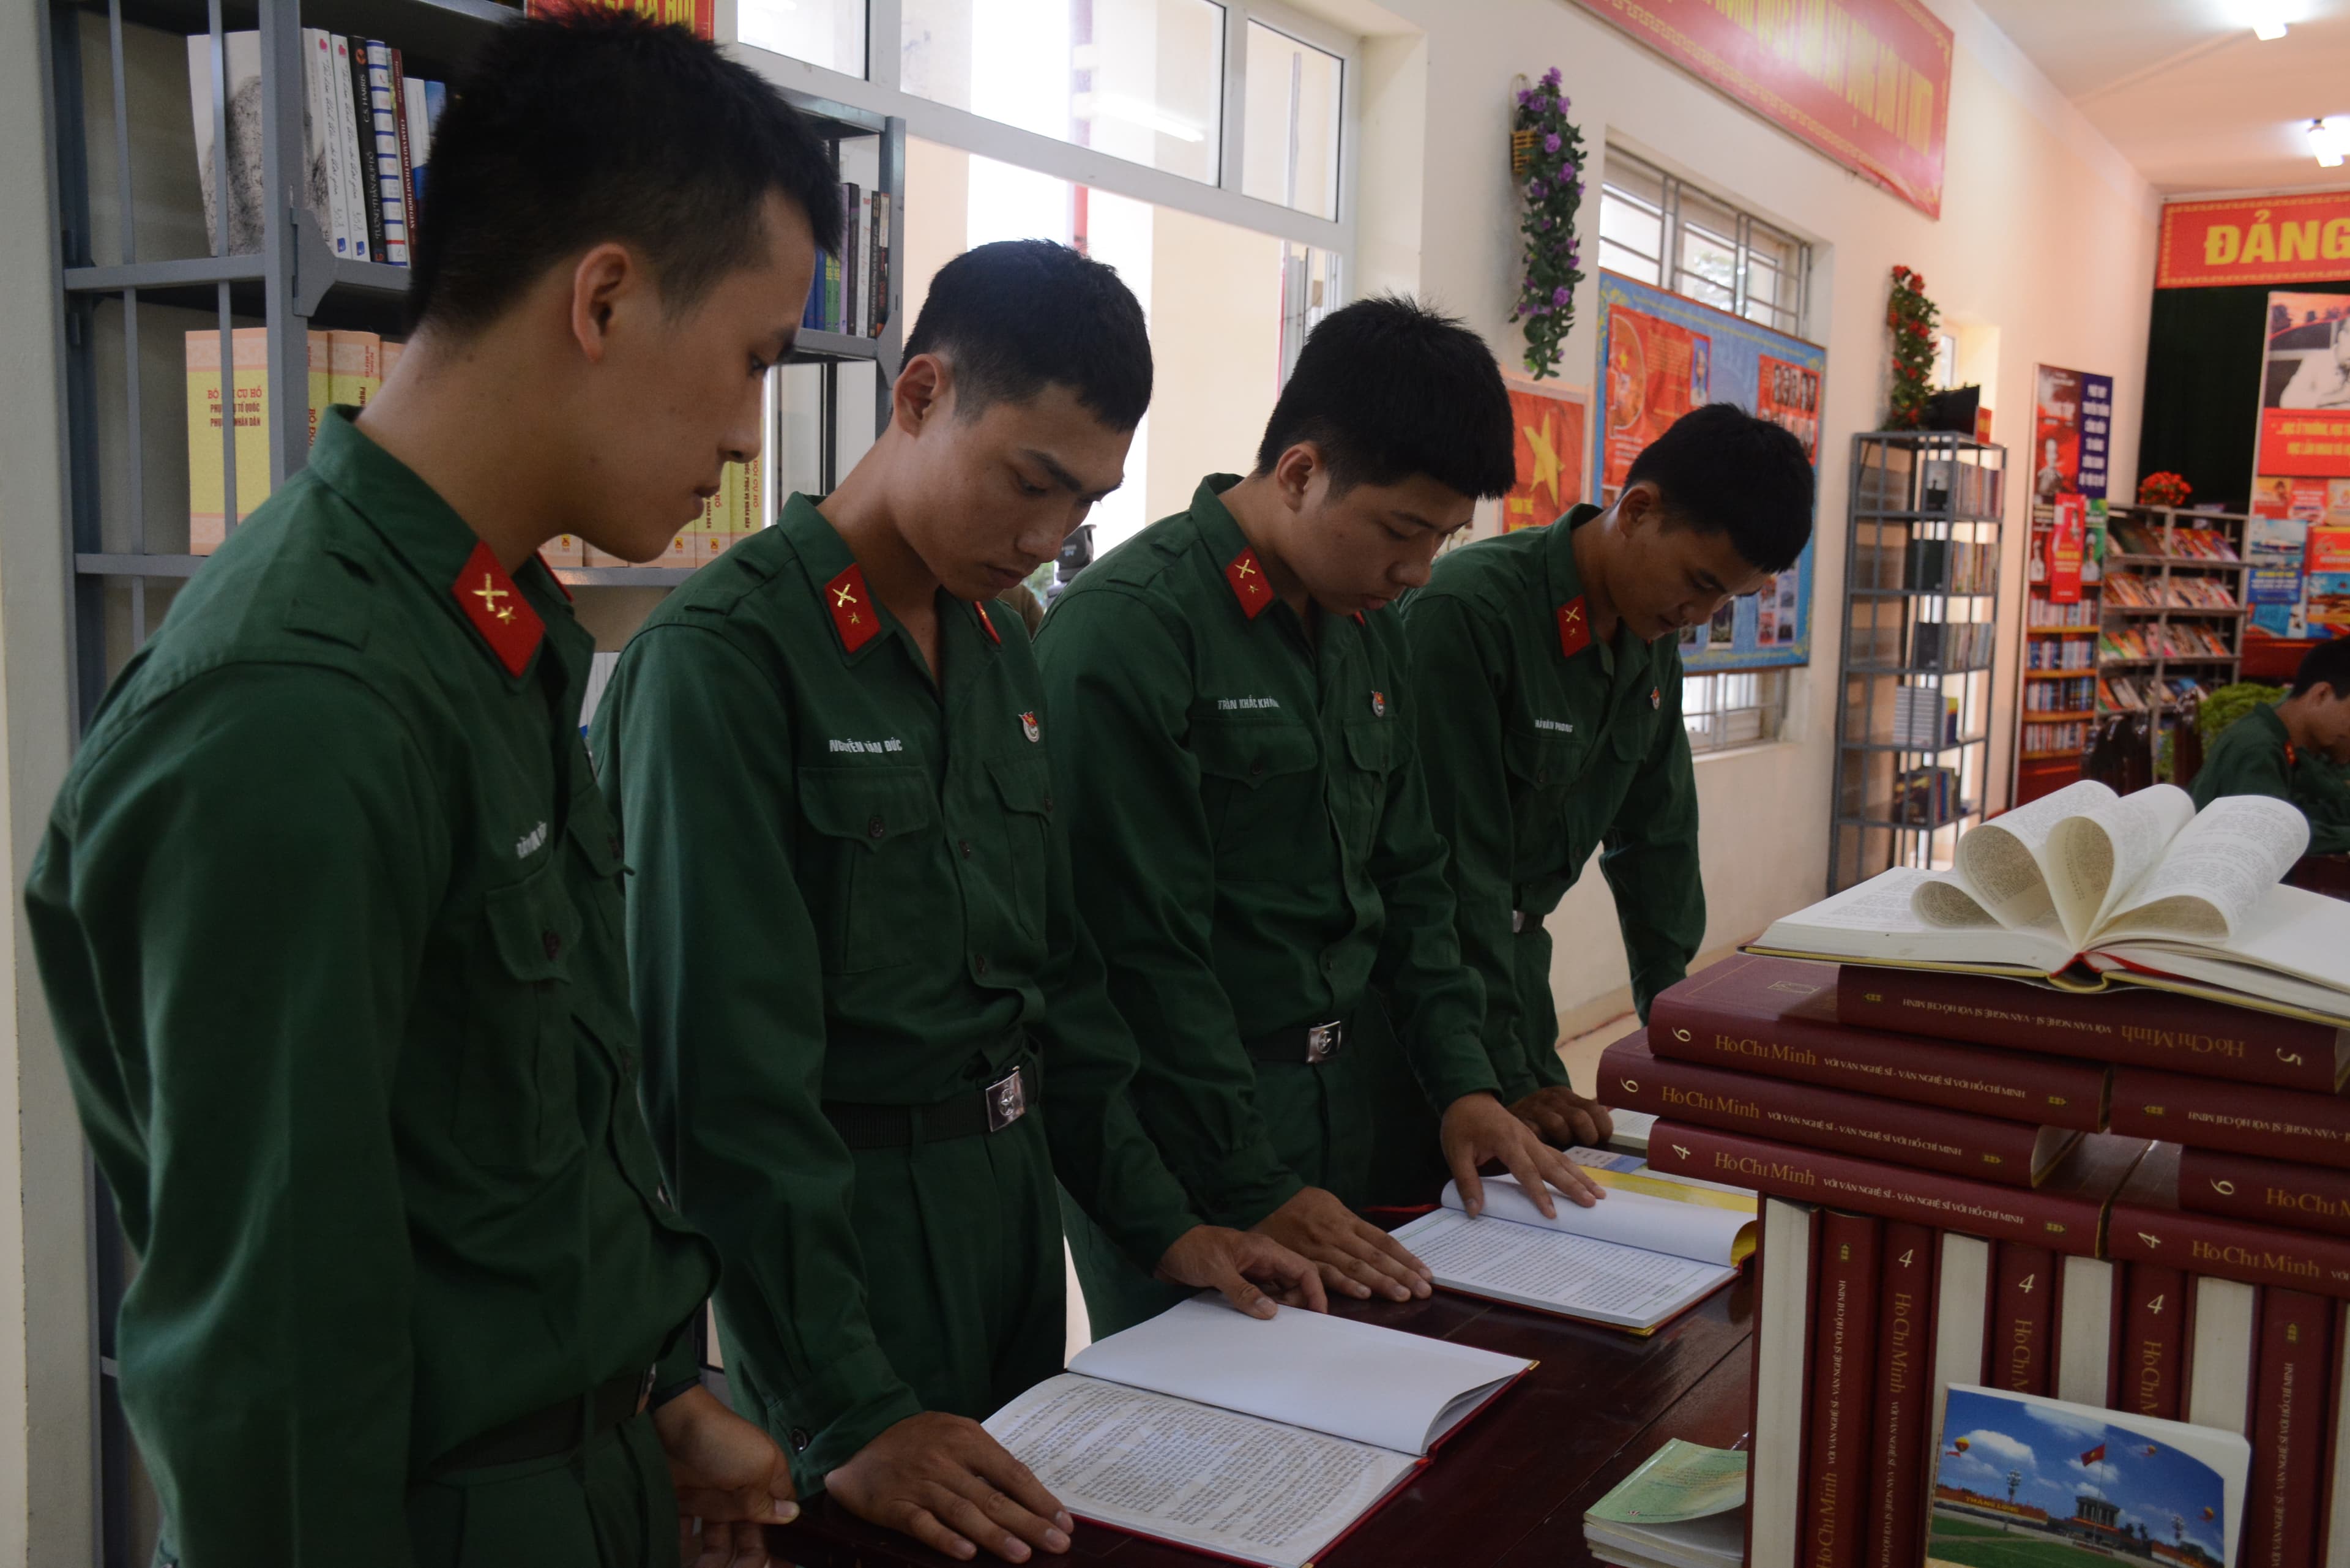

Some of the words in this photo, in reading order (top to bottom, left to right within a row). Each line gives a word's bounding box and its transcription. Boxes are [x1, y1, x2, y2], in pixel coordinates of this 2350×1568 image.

[360, 74, 370, 106] HARRIS
[2204, 209, 2350, 265] ĐẢNG
[2276, 1047, 2302, 1066] 5
[1772, 1044, 1816, 1066] Minh
[2001, 1086, 2025, 1098] MINH
[1717, 1097, 1760, 1119] Minh
[1938, 1144, 1961, 1155] MINH
[1672, 1144, 1691, 1160] 4
[1771, 1163, 1815, 1185] Minh
[1999, 1212, 2024, 1224] MINH
[2138, 1232, 2161, 1249] 4
[1898, 1249, 1914, 1268] 4
[2264, 1253, 2321, 1278] Minh
[2018, 1274, 2035, 1293] 4
[2147, 1294, 2165, 1314] 4
[1890, 1348, 1908, 1394] Minh
[1819, 1472, 1838, 1514] Minh
